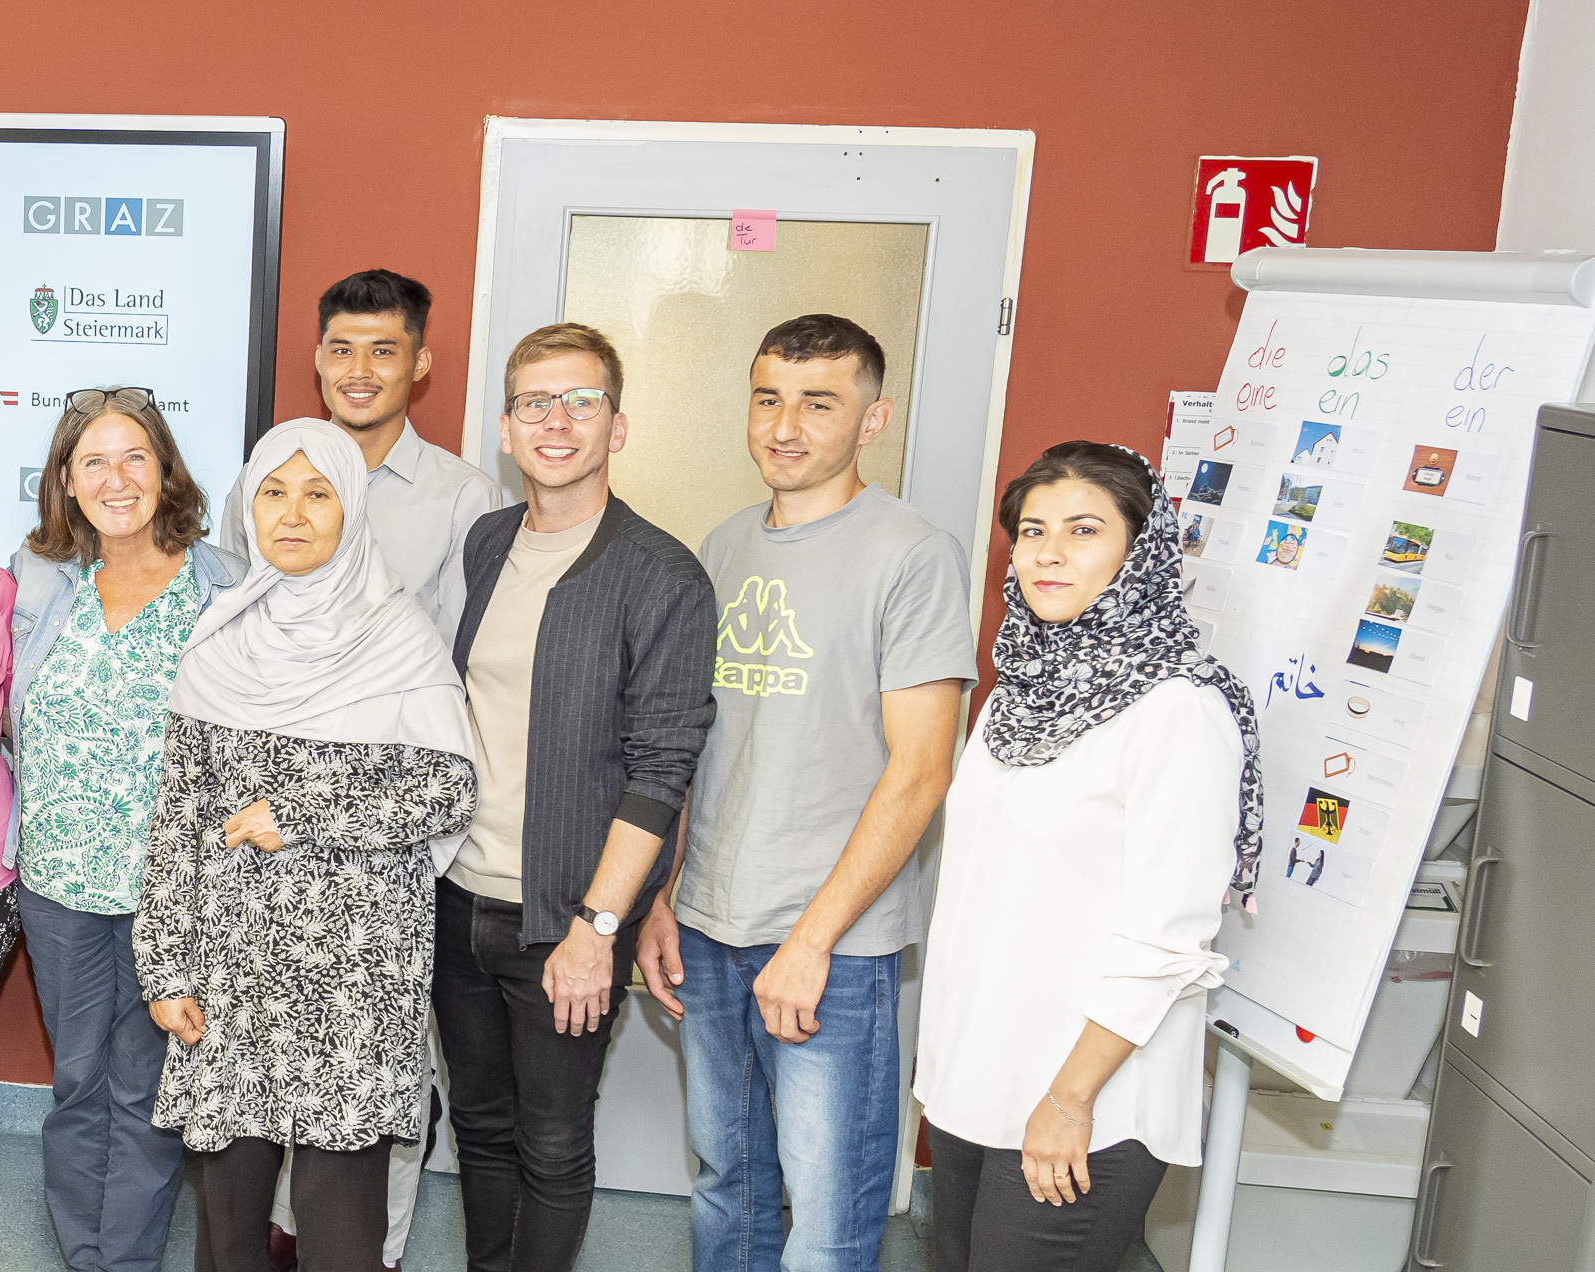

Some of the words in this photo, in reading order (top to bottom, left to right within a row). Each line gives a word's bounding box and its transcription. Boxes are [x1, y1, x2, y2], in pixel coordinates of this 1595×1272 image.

[28, 200, 176, 233] GRAZ
[69, 286, 106, 307] Das
[113, 288, 164, 309] Land
[63, 318, 164, 339] Steiermark
[1248, 319, 1286, 369] die
[1327, 325, 1390, 380] das
[1453, 333, 1515, 391] der
[1236, 382, 1277, 412] eine
[1318, 389, 1360, 420] ein
[1445, 405, 1486, 433] ein
